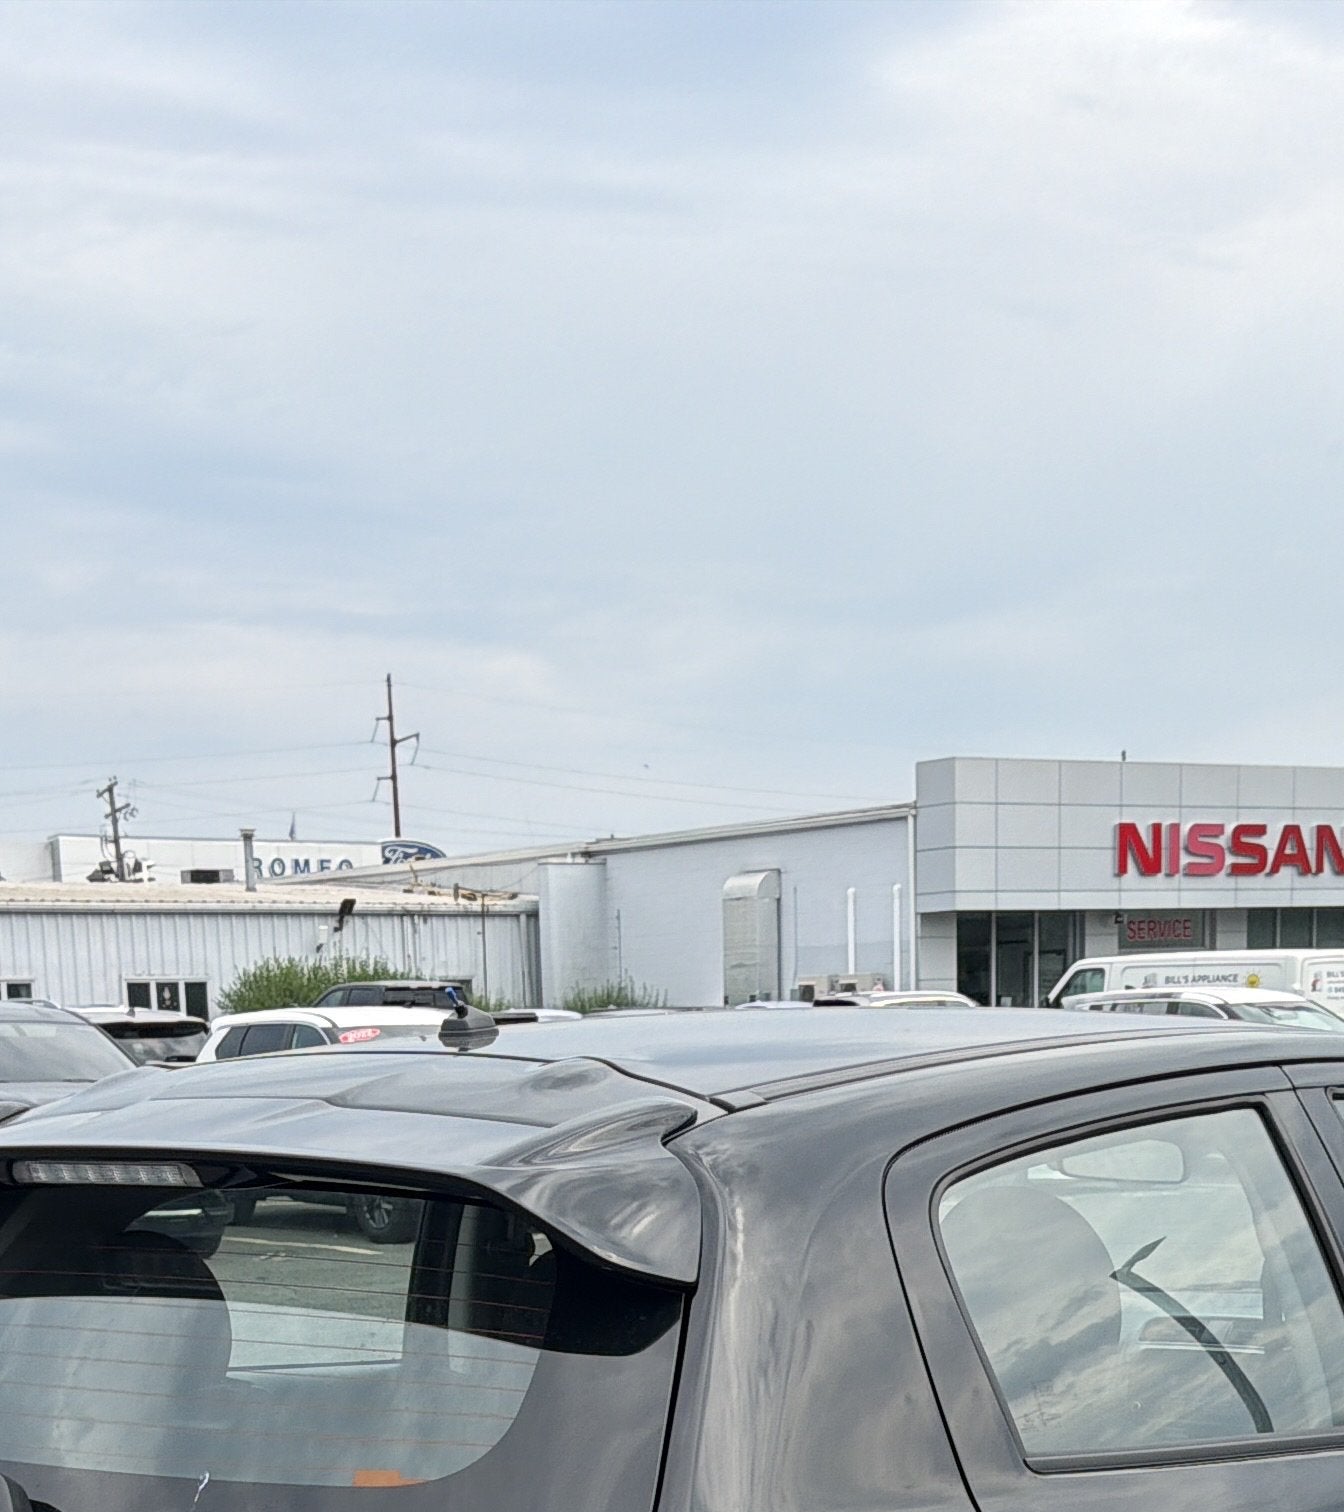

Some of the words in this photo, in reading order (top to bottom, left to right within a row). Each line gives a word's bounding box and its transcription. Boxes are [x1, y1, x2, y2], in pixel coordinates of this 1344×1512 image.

[1127, 918, 1192, 941] SERVICE
[1164, 974, 1189, 985] BILL'S
[1190, 973, 1239, 984] APPLIANCE
[1326, 970, 1344, 978] BILL'S
